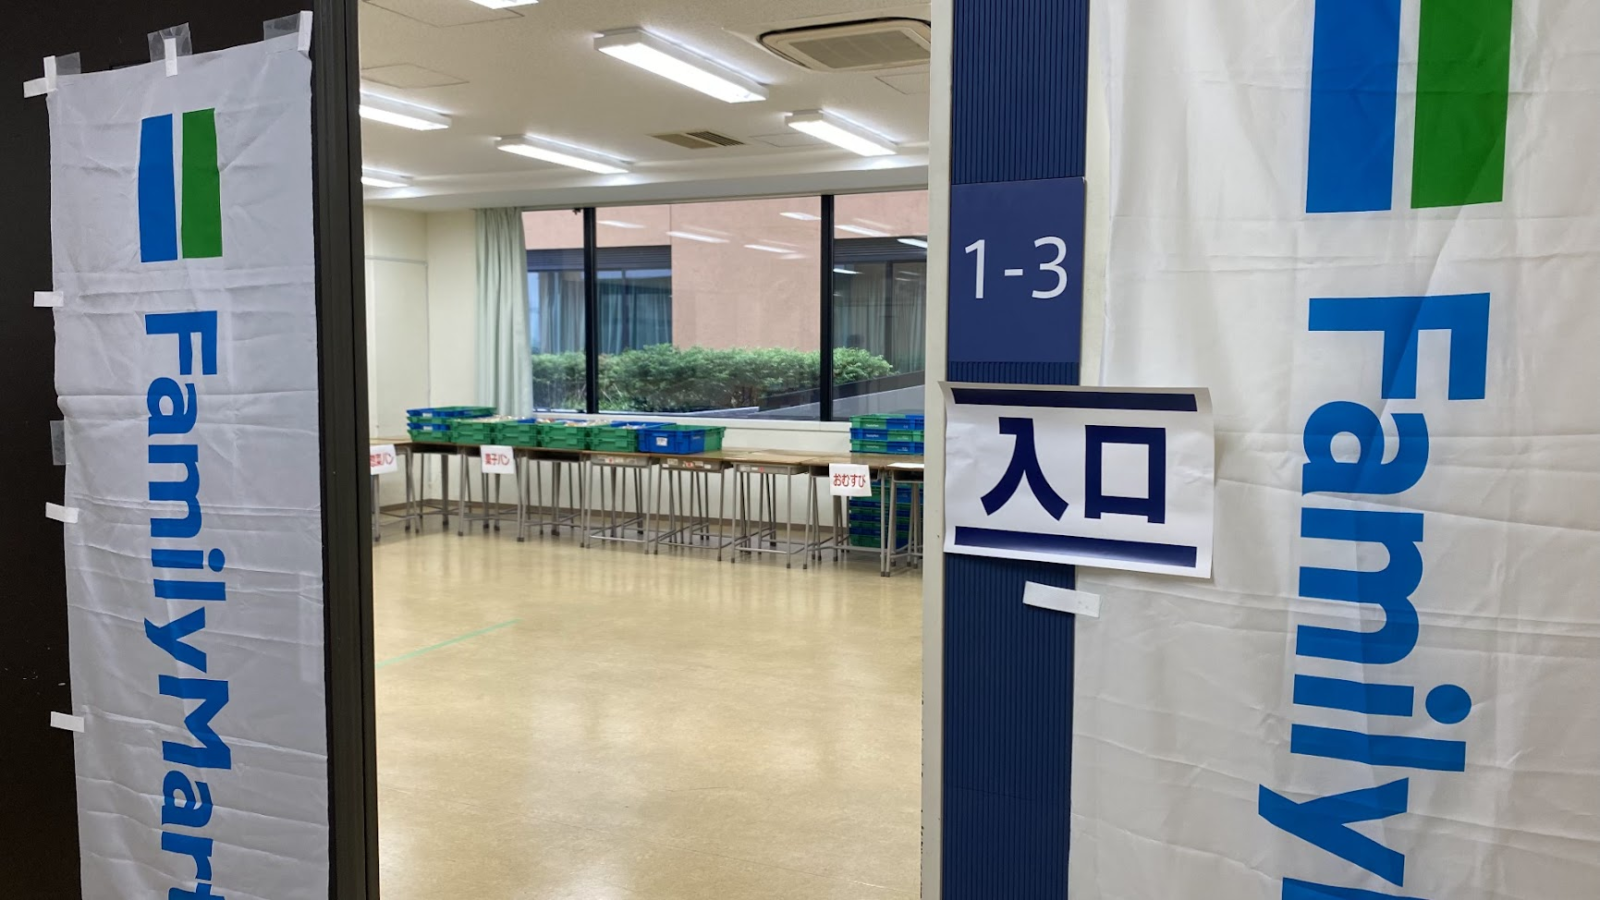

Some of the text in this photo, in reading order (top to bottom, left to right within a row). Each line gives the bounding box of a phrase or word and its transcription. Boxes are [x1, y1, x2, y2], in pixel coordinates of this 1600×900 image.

[964, 236, 1069, 299] 1-3
[833, 473, 866, 488] おむすび
[980, 416, 1167, 525] 入口
[1257, 292, 1491, 900] Family
